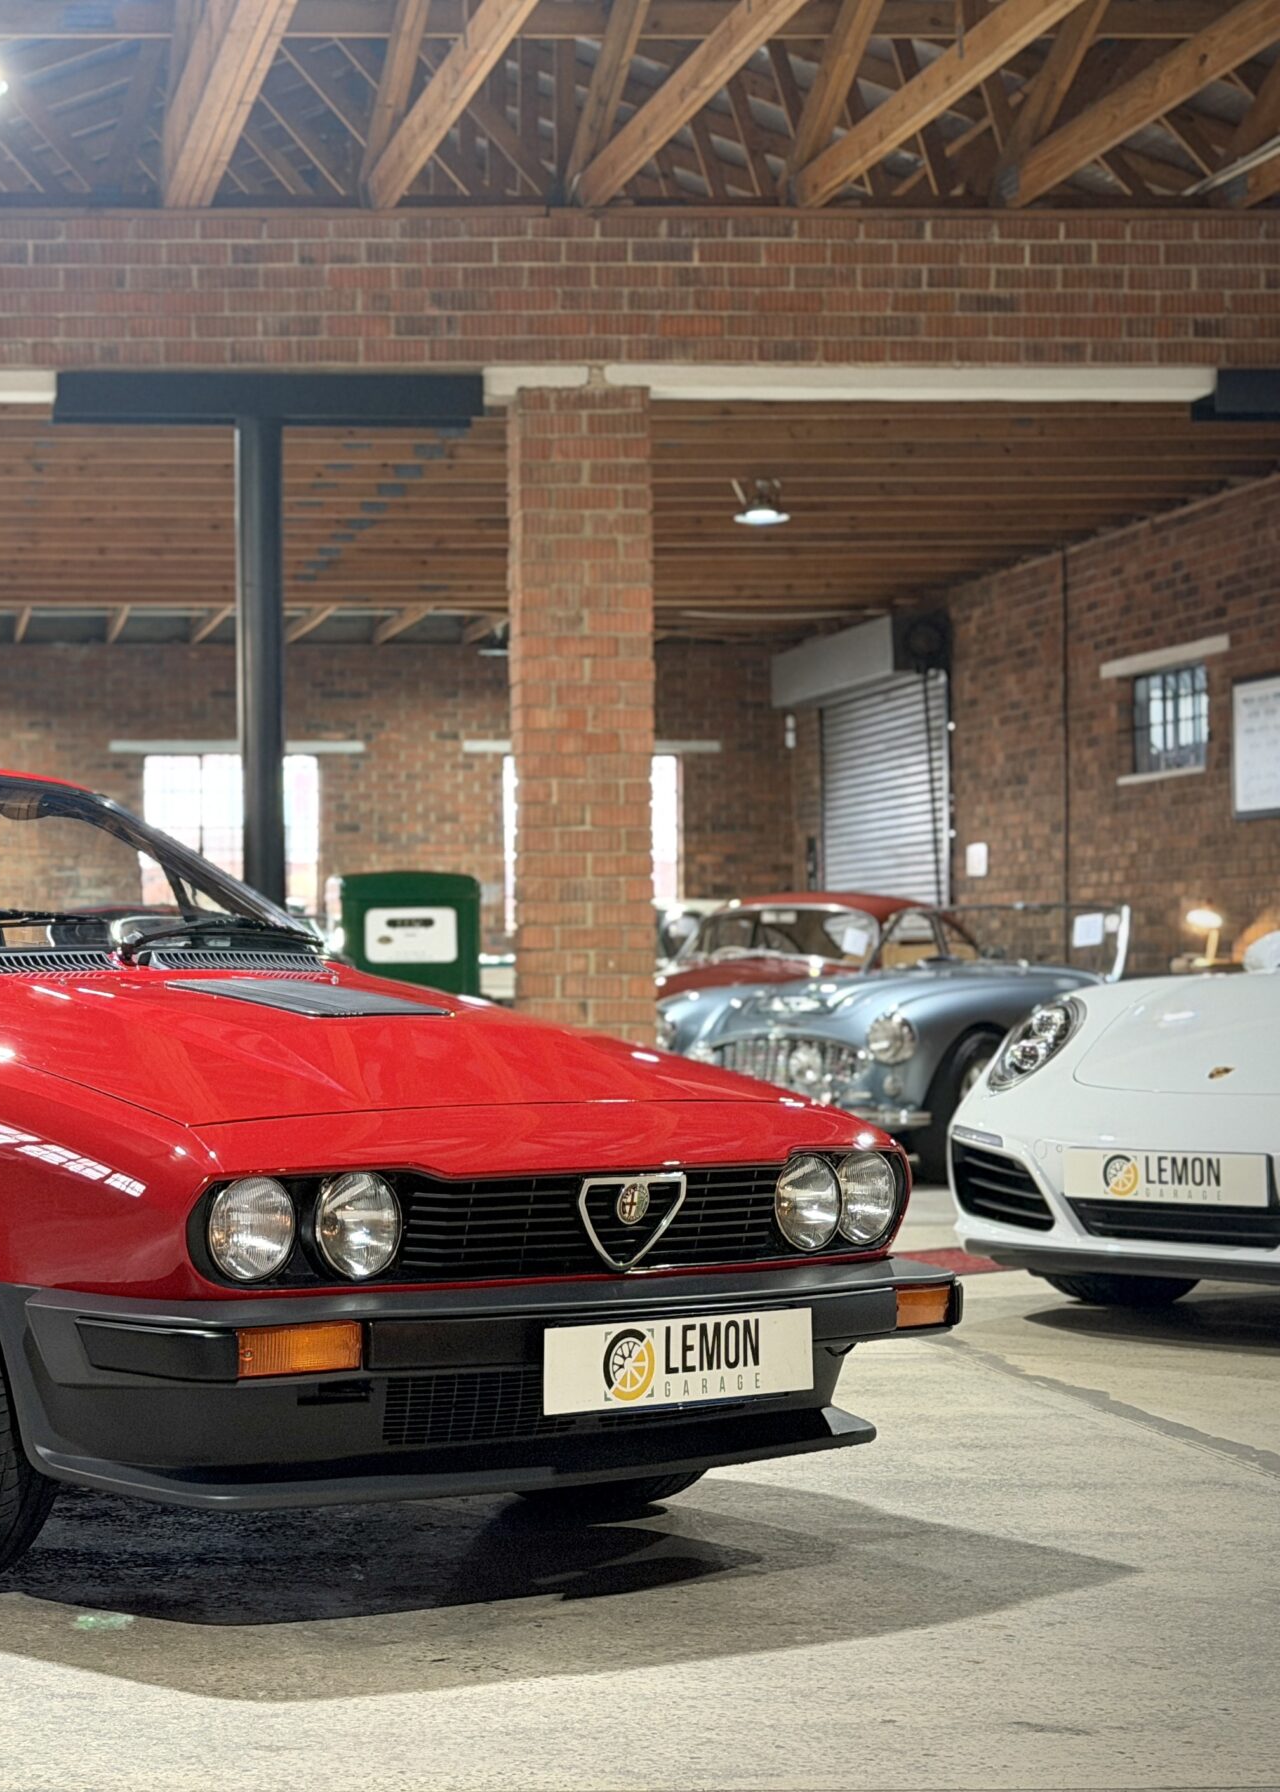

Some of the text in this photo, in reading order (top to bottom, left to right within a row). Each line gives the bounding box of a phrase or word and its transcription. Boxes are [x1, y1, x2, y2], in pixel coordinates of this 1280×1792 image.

[1146, 1156, 1221, 1187] LEMON
[1146, 1188, 1222, 1200] GARAGE
[665, 1318, 760, 1374] LEMON
[665, 1373, 760, 1397] GARAGE
